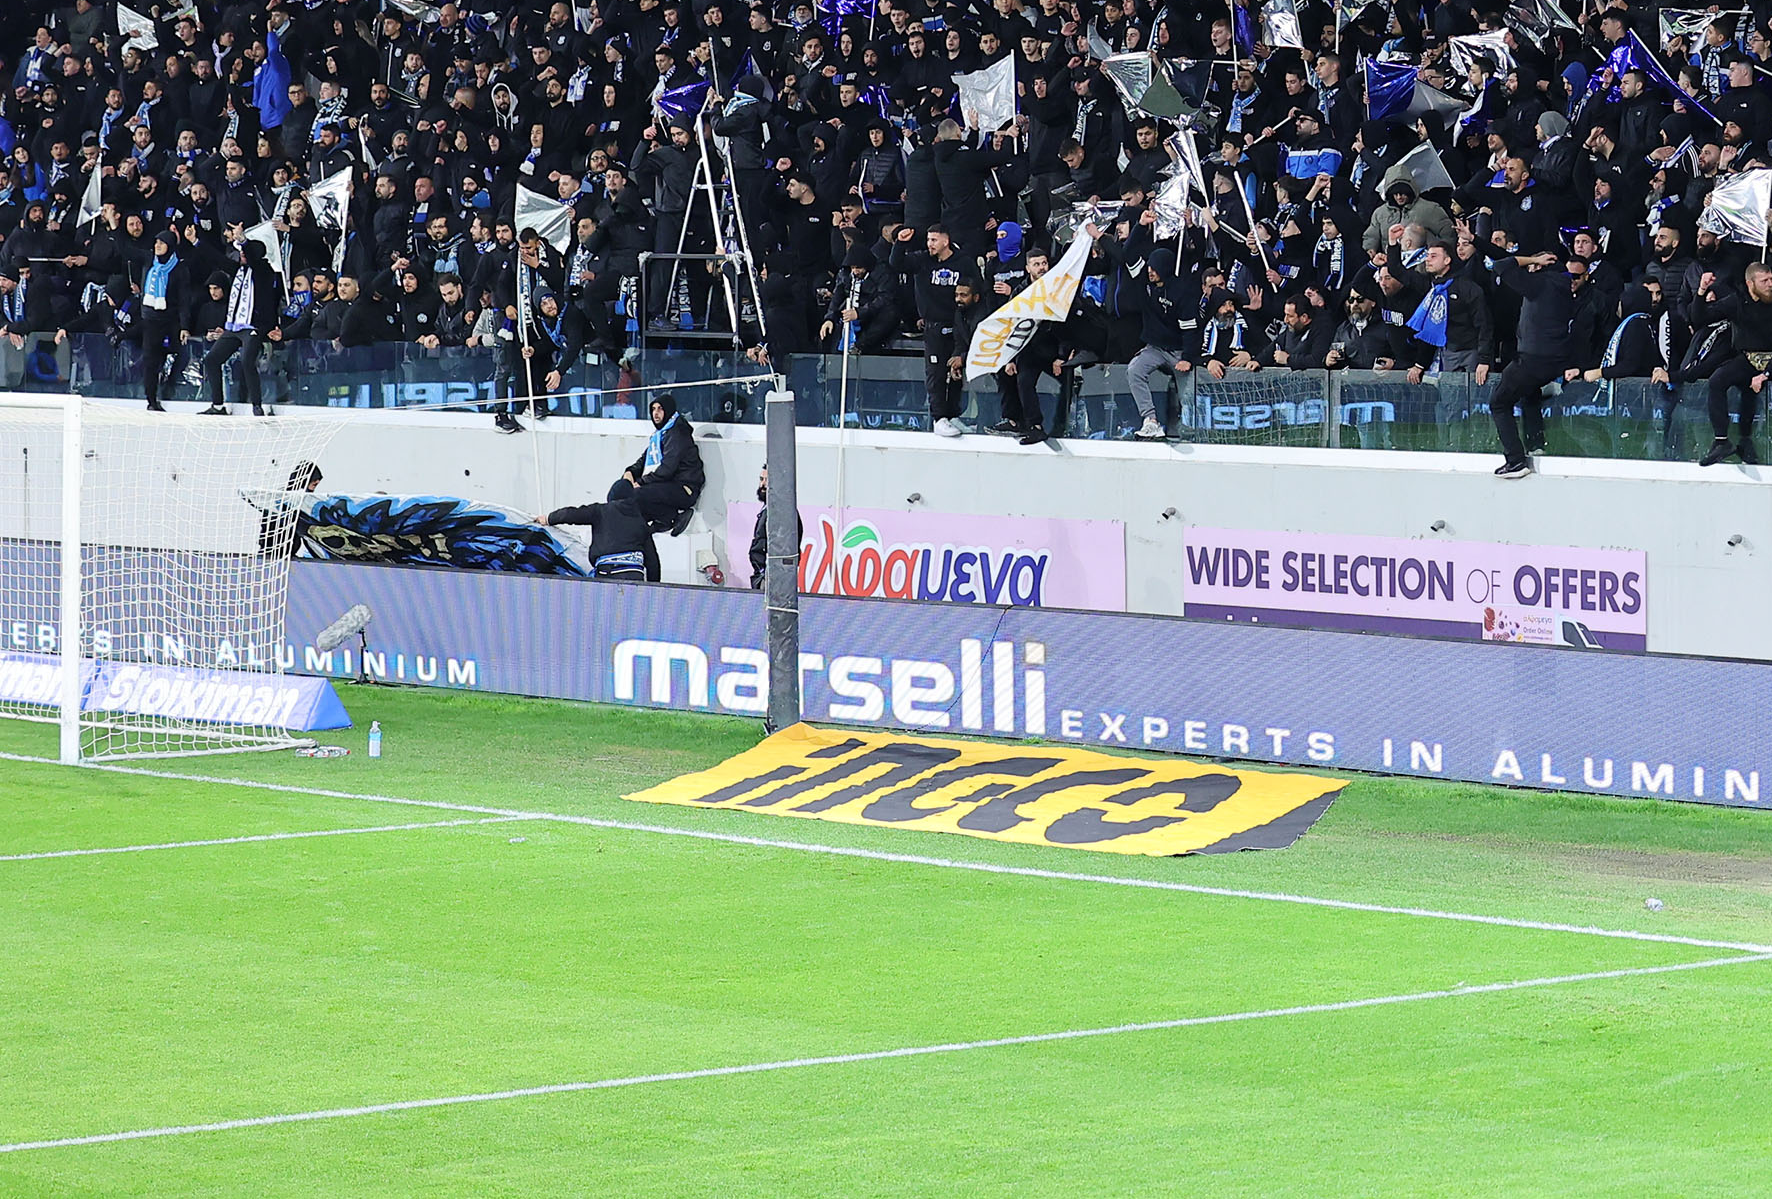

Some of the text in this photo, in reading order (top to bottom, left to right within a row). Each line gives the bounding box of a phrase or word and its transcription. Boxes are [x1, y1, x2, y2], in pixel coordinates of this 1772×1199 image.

[1185, 545, 1642, 615] WIDE SELECTION OF OFFERS
[216, 638, 477, 686] ALUMINIUM
[1061, 709, 1334, 761] EXPERTS
[1383, 738, 1442, 772] IN
